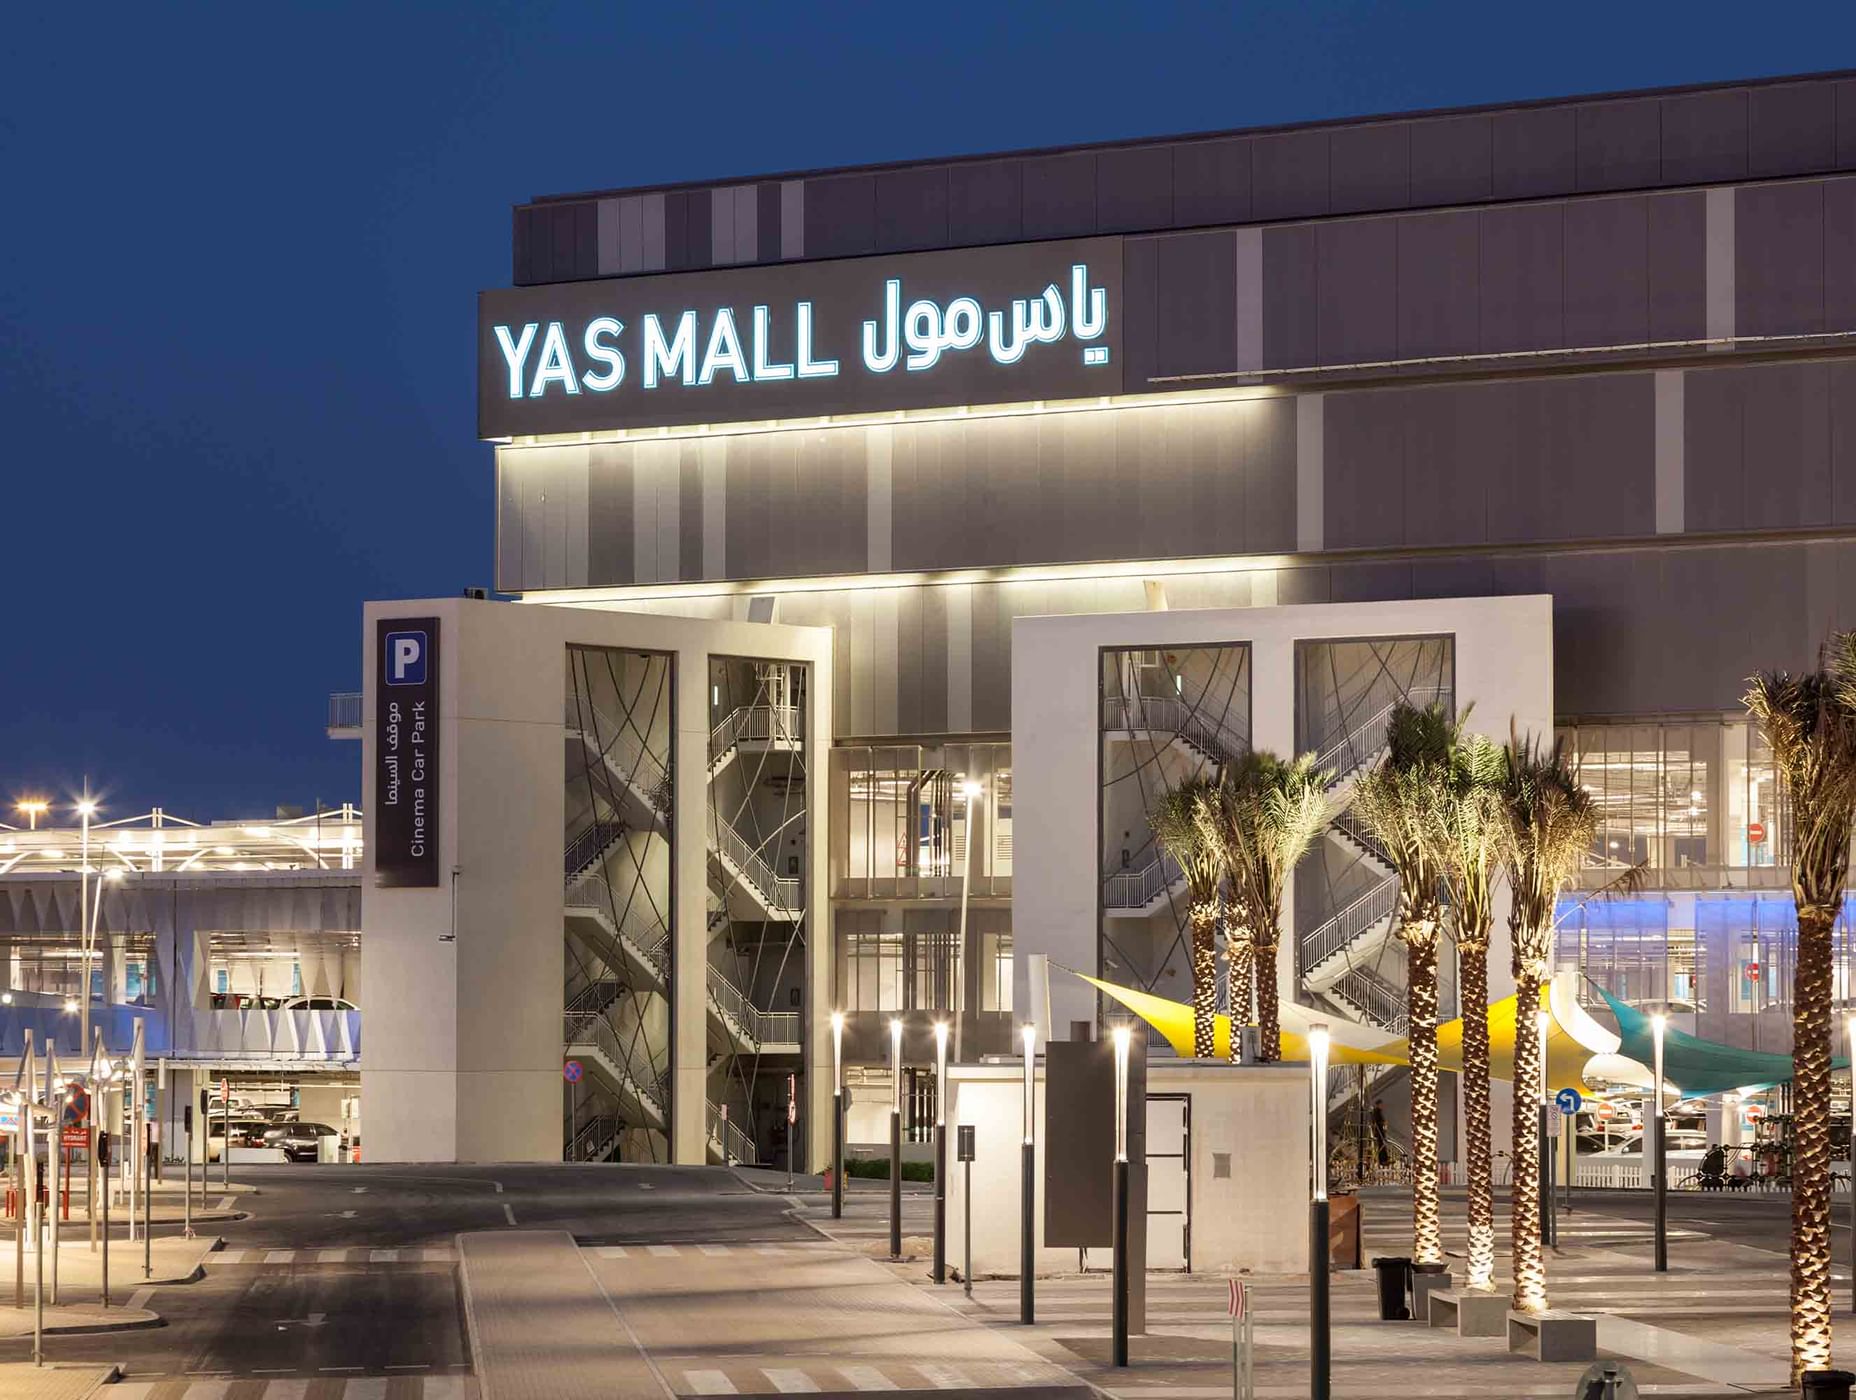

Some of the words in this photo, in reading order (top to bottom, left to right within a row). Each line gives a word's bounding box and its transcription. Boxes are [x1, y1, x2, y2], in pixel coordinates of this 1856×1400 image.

[863, 279, 985, 373] مول
[988, 264, 1109, 365] ياس
[493, 316, 626, 398] YAS
[643, 302, 839, 389] MALL
[394, 638, 420, 679] P
[386, 702, 402, 751] موقف
[411, 701, 425, 743] Park
[384, 755, 401, 805] السينما
[411, 748, 425, 781] Car
[411, 788, 425, 857] Cinema
